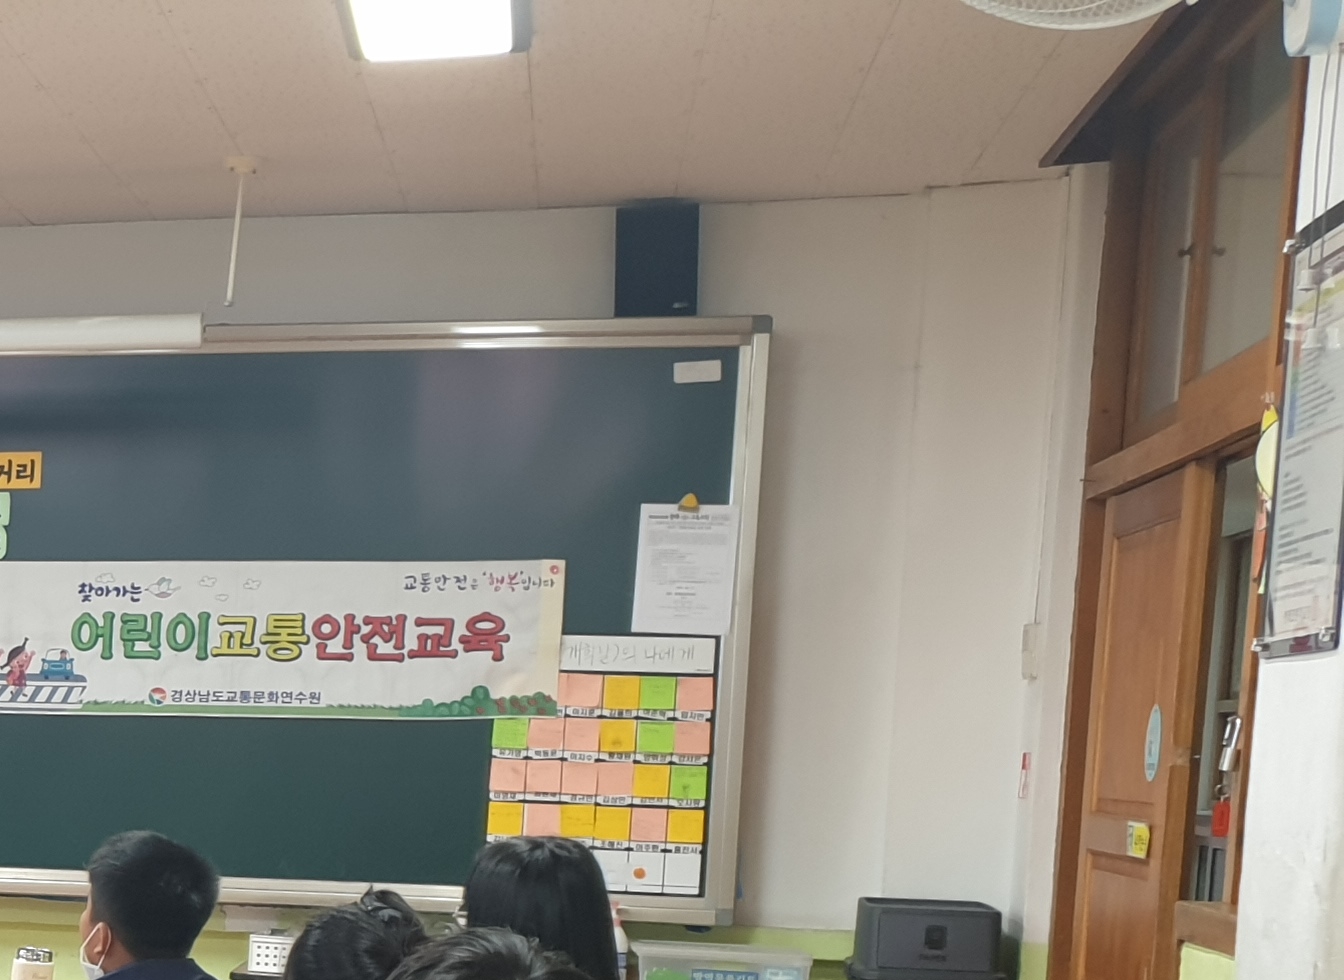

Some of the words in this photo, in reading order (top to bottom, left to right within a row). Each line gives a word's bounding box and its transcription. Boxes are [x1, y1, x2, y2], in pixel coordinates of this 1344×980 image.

[78, 582, 142, 603] 찾아가는
[403, 572, 480, 593] 교통안전은
[71, 611, 510, 662] 어린이교통안전교육
[170, 690, 321, 705] 경상남도교통문화연수원
